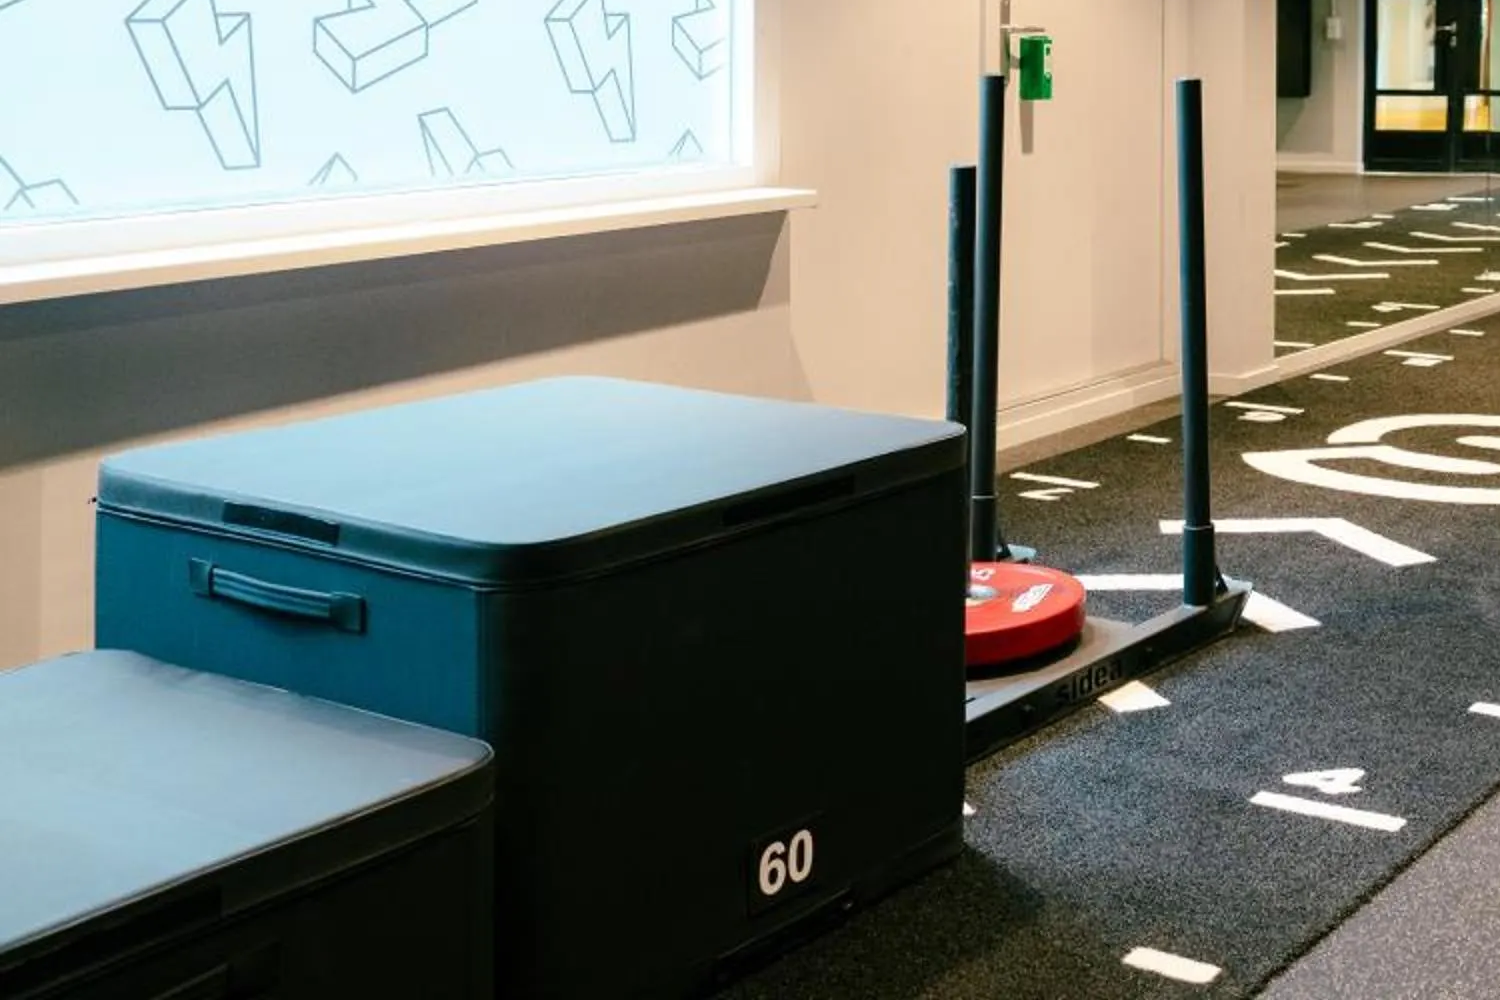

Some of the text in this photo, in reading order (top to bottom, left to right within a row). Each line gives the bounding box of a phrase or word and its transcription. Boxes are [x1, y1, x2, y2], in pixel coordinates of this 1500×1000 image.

[1057, 660, 1122, 705] sidea
[1282, 767, 1365, 794] 4
[759, 829, 813, 896] 60
